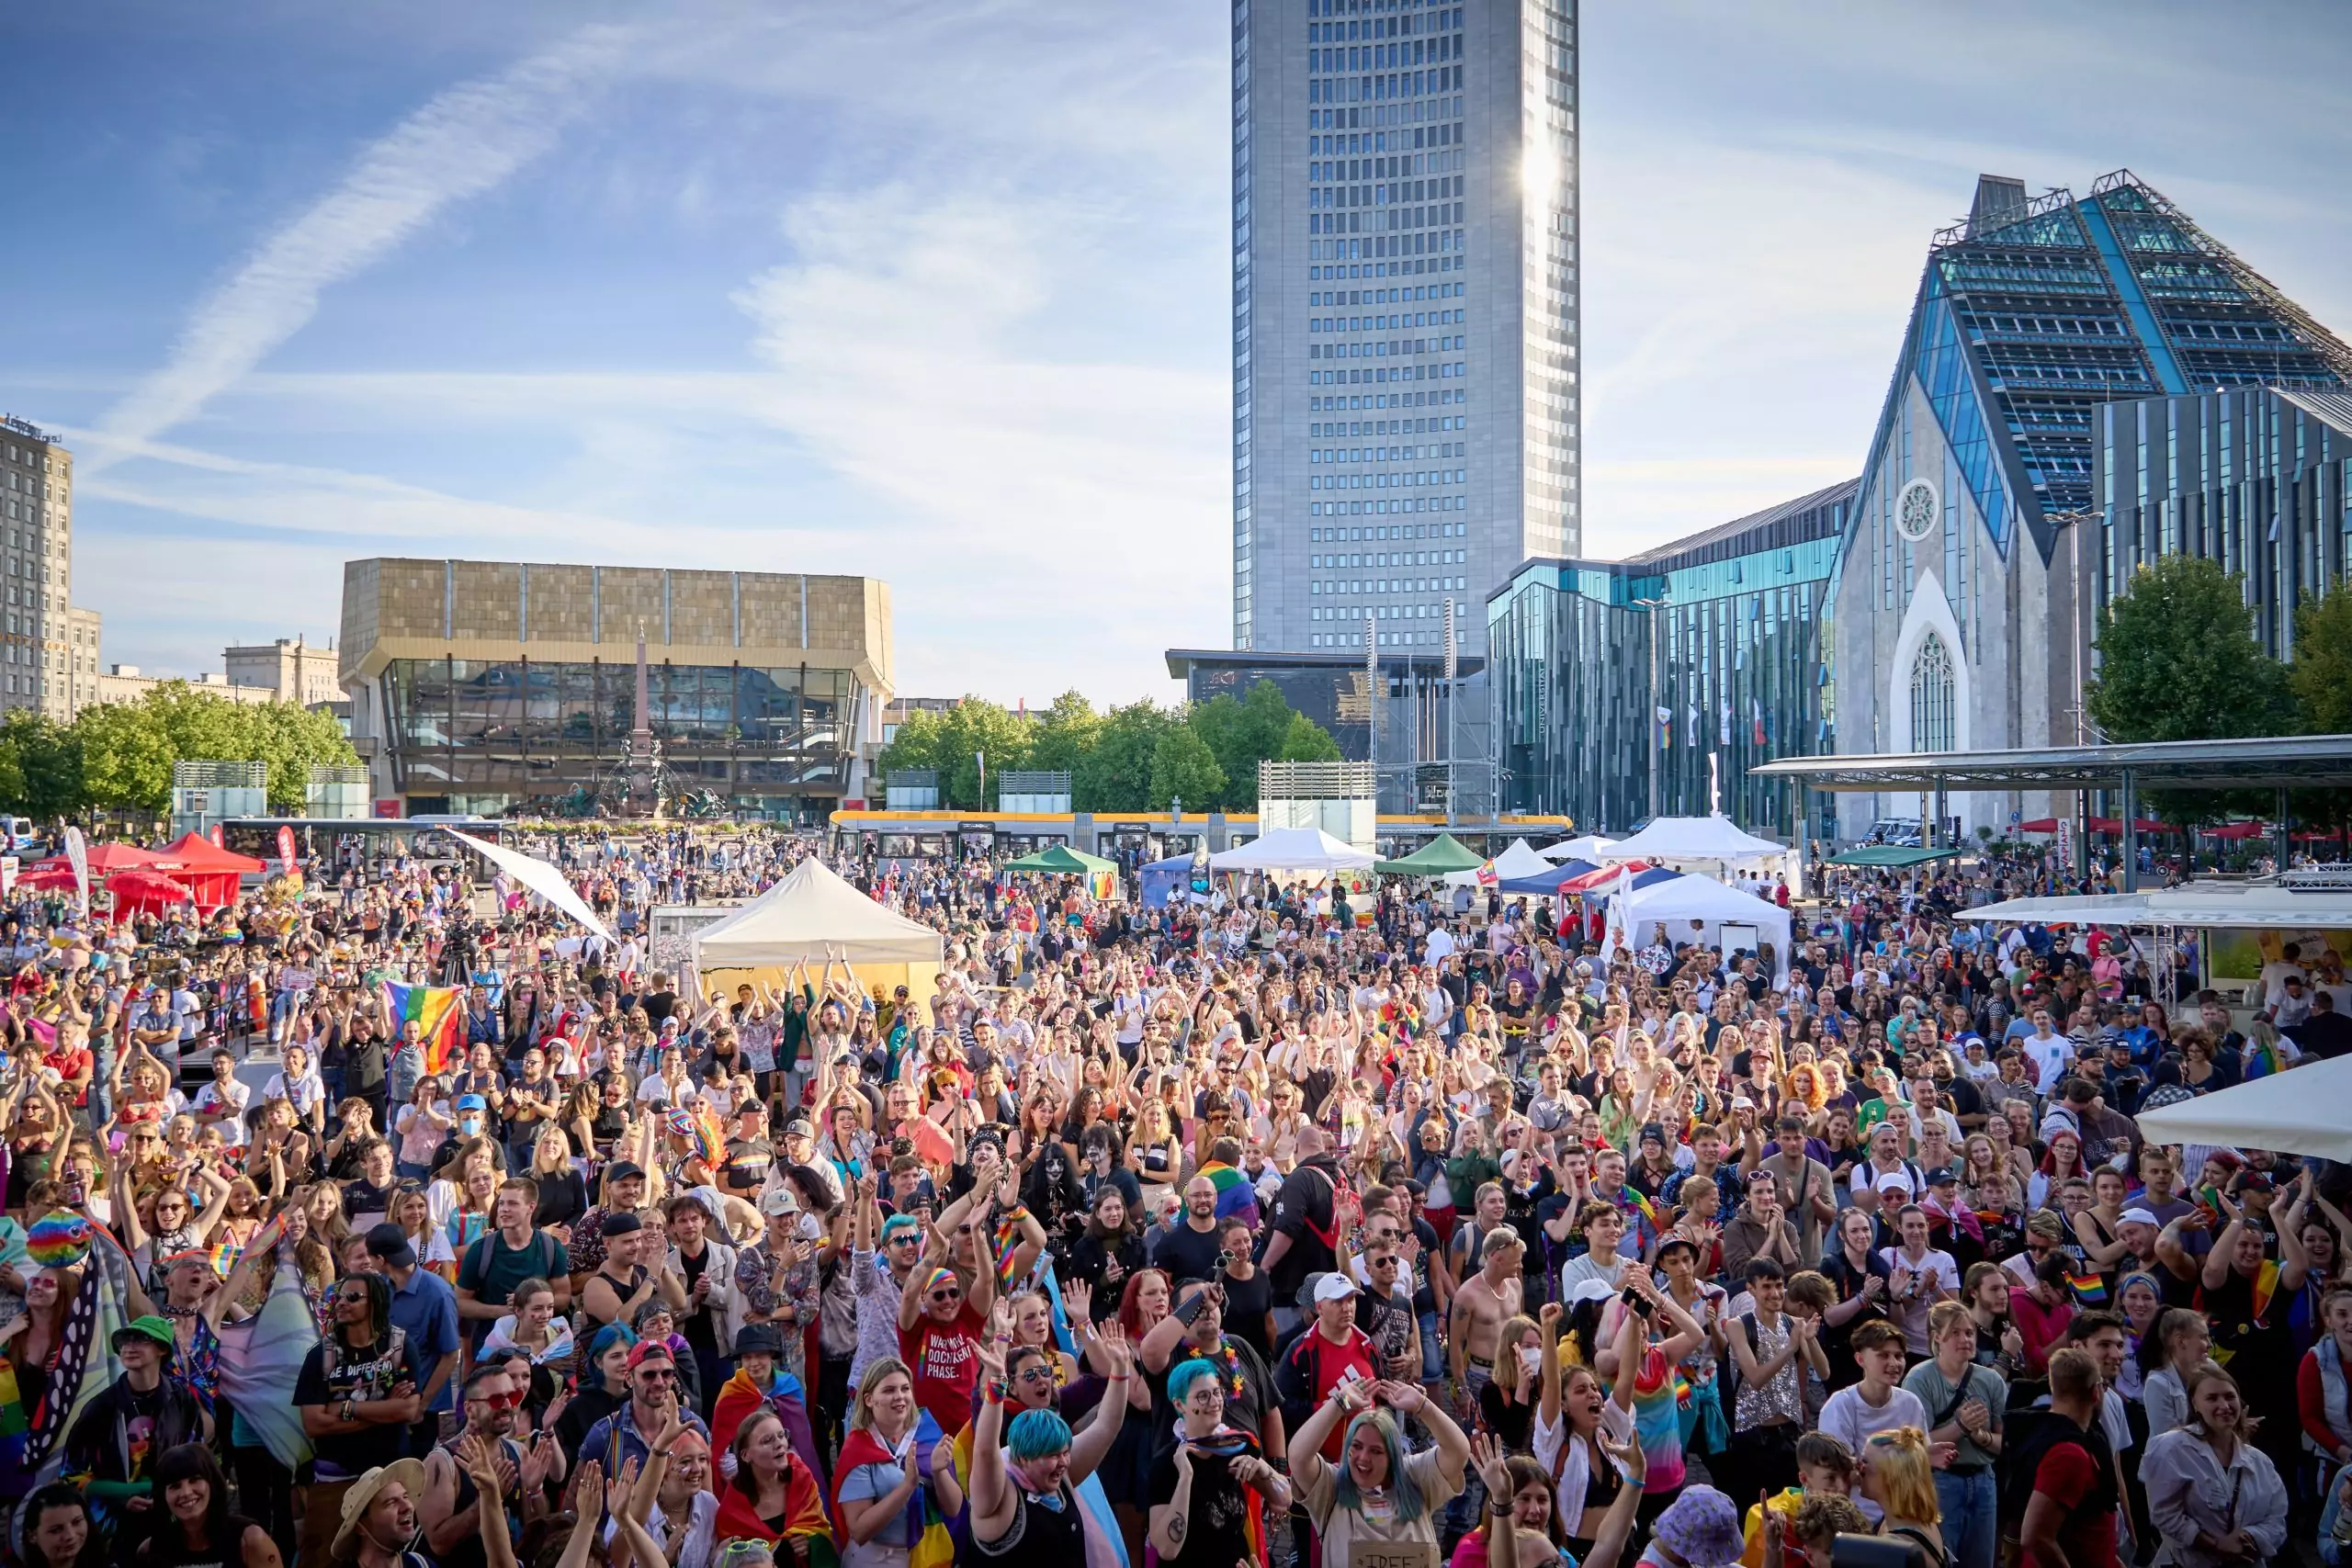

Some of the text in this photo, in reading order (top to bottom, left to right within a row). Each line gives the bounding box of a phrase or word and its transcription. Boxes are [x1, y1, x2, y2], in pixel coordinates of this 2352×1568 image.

[2059, 821, 2068, 866] VAPIANO
[513, 947, 537, 956] LOVE
[930, 1333, 947, 1350] WAR
[928, 1348, 953, 1364] DOCH
[927, 1364, 960, 1379] PHASE.
